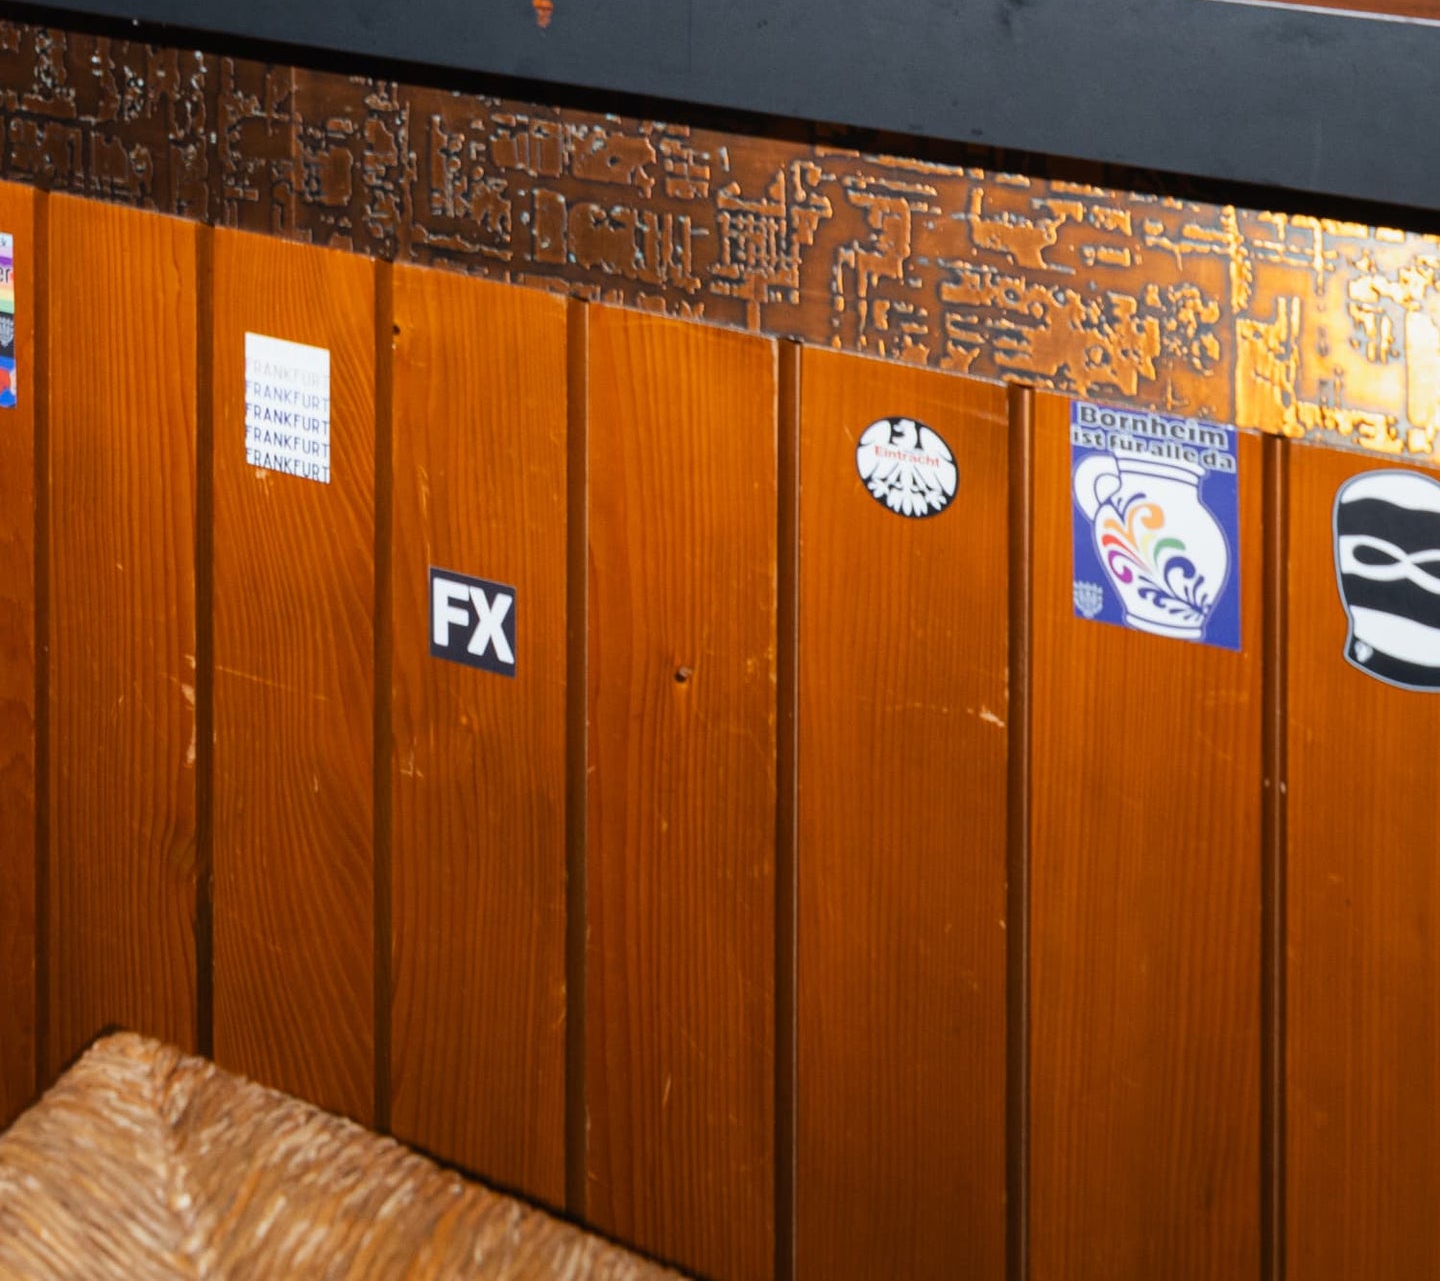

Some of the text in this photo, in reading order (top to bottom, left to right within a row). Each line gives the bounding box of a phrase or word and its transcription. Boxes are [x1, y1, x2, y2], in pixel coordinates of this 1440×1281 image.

[245, 380, 330, 412] FRANKFURT
[245, 402, 330, 435] FRANKFURT
[1079, 404, 1225, 446] Bornheim
[245, 425, 330, 458] FRANKFURT
[874, 445, 941, 467] Eintracht
[1074, 426, 1103, 444] ist
[1150, 442, 1196, 463] alle
[1202, 452, 1233, 470] da
[245, 446, 330, 484] FRANKFURT
[433, 577, 515, 665] FX
